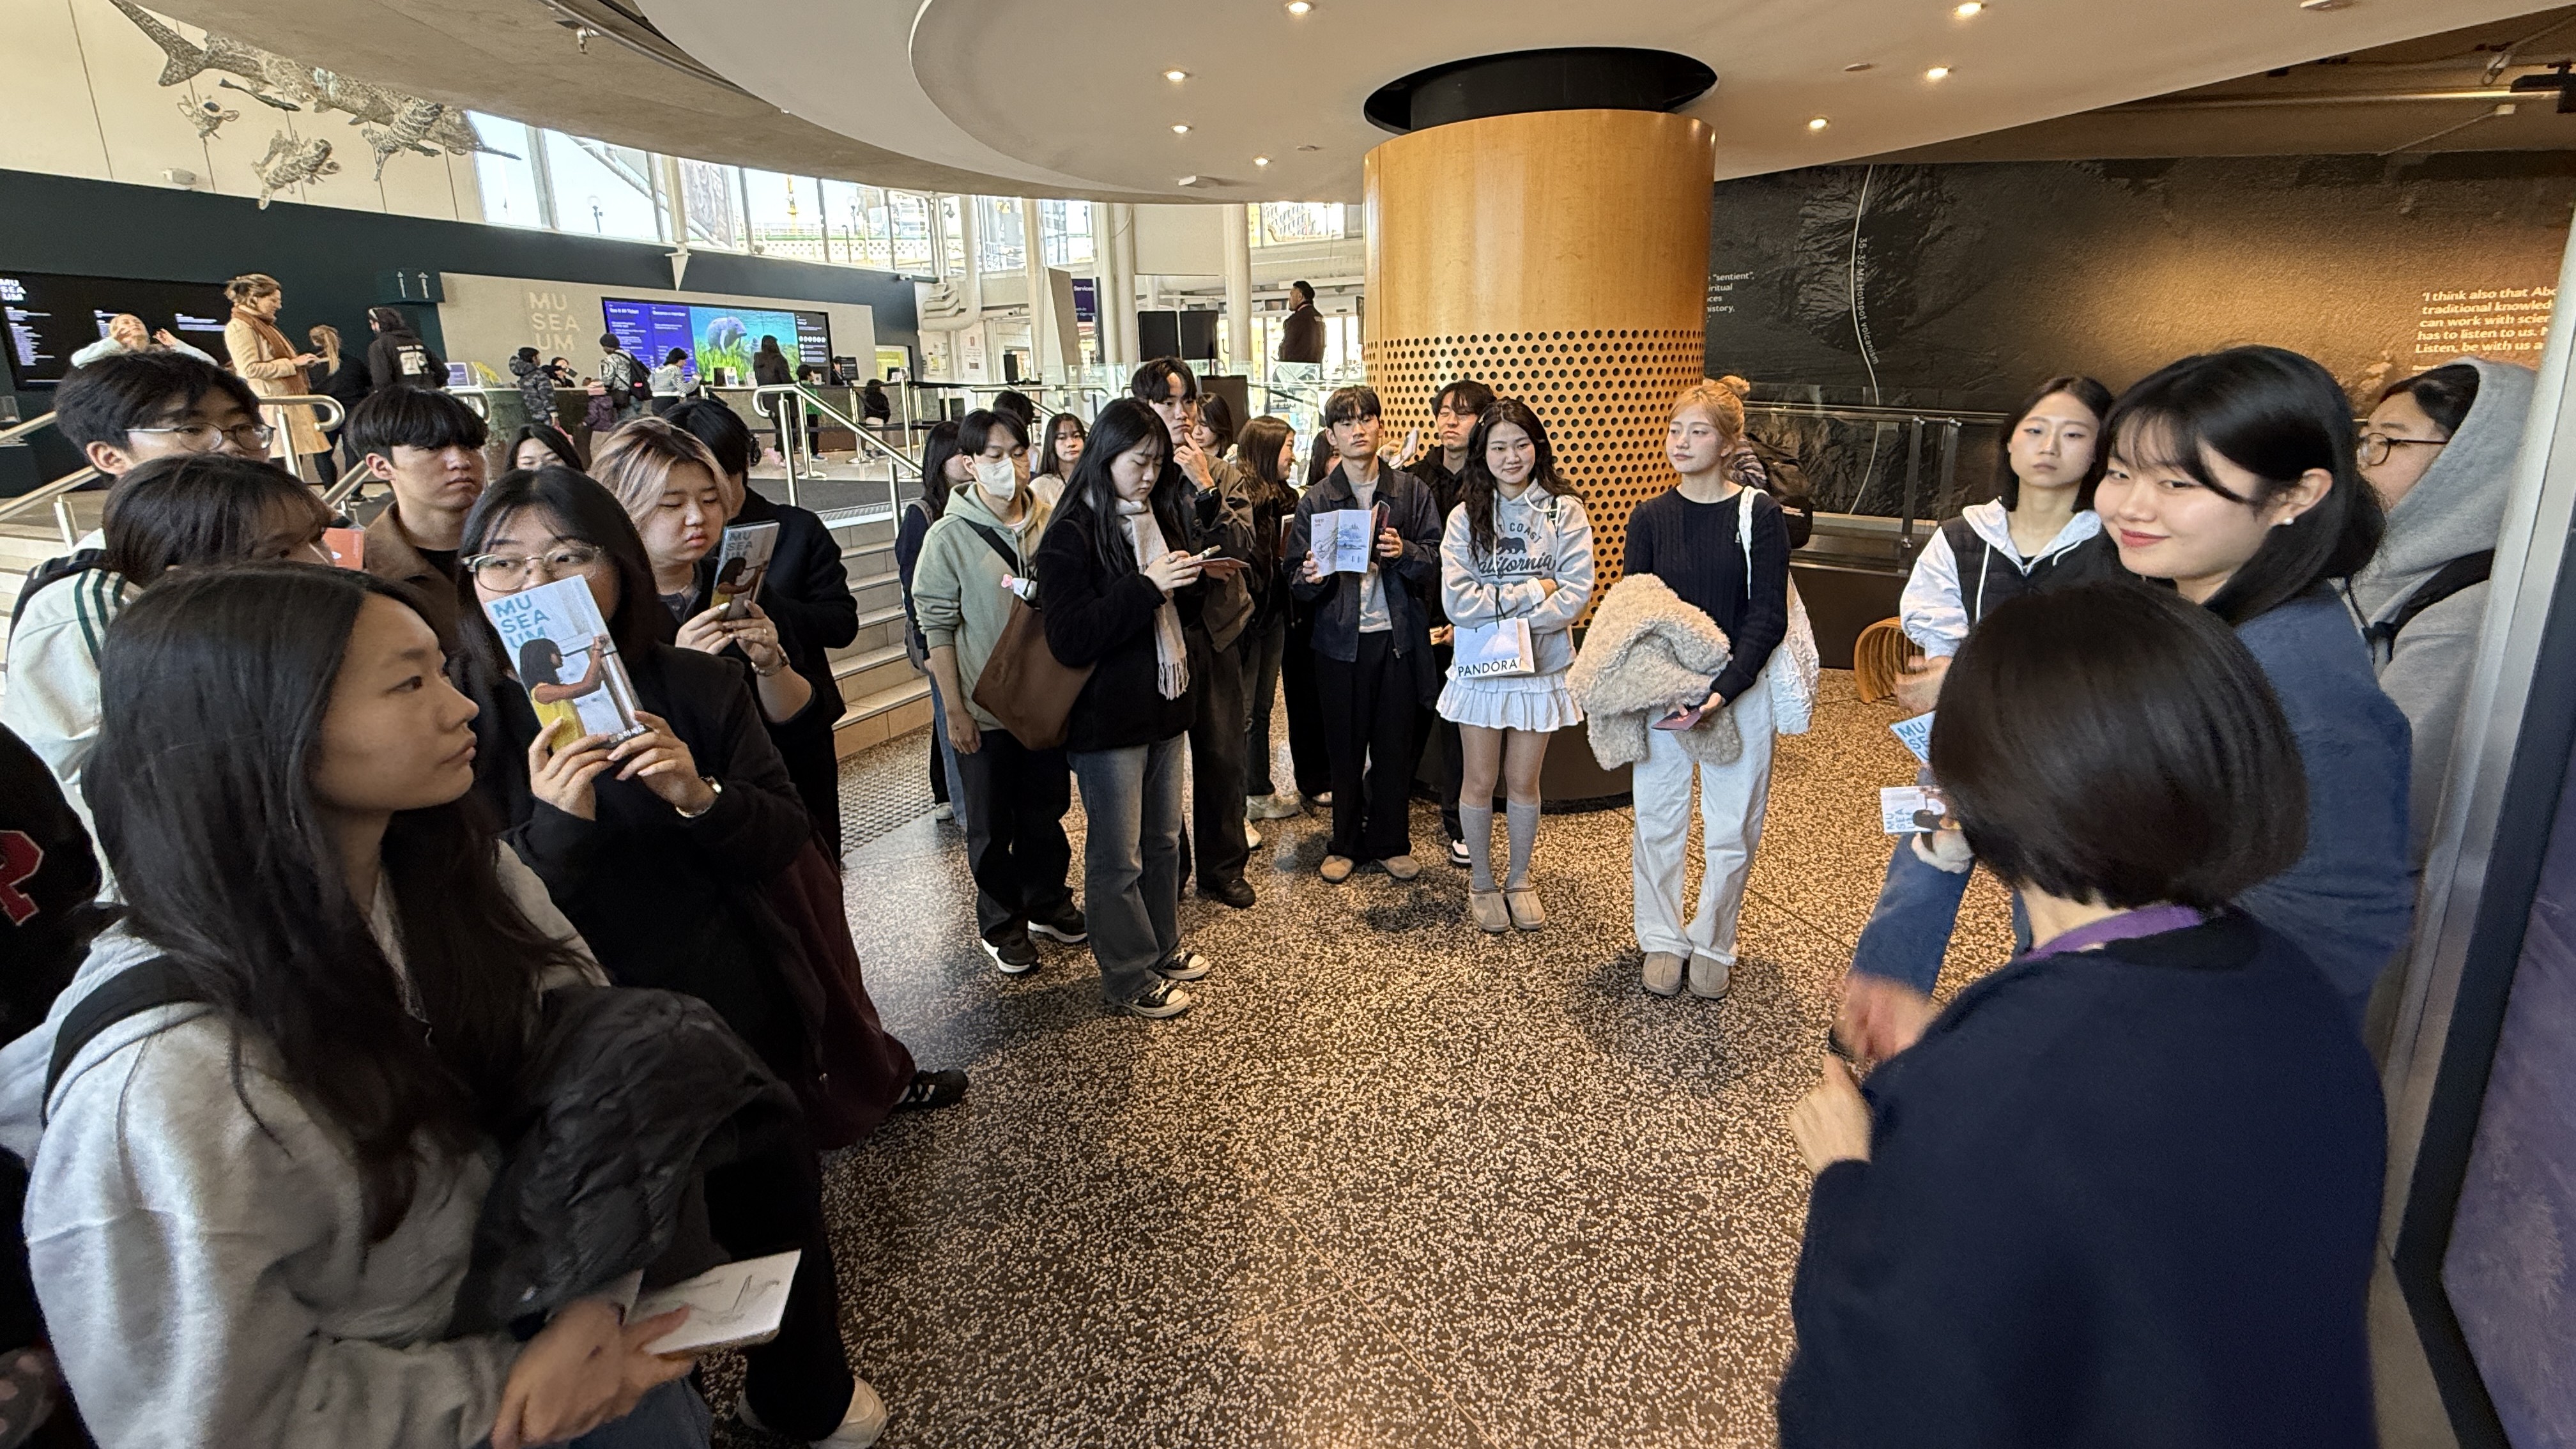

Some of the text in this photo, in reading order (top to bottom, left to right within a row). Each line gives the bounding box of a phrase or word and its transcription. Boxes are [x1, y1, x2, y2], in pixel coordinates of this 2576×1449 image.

[528, 291, 567, 310] MU
[1855, 284, 1867, 321] Hotspot
[2432, 290, 2467, 301] think
[2469, 289, 2497, 300] also
[2499, 288, 2528, 298] that
[2422, 302, 2492, 315] traditional
[532, 312, 581, 331] SEA
[2419, 319, 2444, 328] can
[2447, 315, 2481, 326] work
[2484, 314, 2515, 325] with
[535, 332, 575, 351] UM
[1860, 321, 1879, 365] volcanism
[2417, 330, 2441, 341] has
[2442, 331, 2458, 339] to
[2460, 329, 2497, 339] listen
[2499, 329, 2516, 338] to
[2517, 329, 2538, 337] us.
[2415, 344, 2459, 353] Listen,
[2461, 342, 2479, 352] be
[2481, 340, 2512, 351] with
[2514, 342, 2531, 350] us
[1509, 522, 1542, 544] COAST
[727, 540, 753, 551] SEA
[1478, 551, 1557, 579] alifornia
[492, 594, 533, 618] MU
[501, 609, 551, 634] SEA
[1457, 658, 1518, 677] PANDORA
[1897, 721, 1927, 739] MU
[1885, 813, 1895, 830] MU
[1895, 808, 1906, 830] SEA
